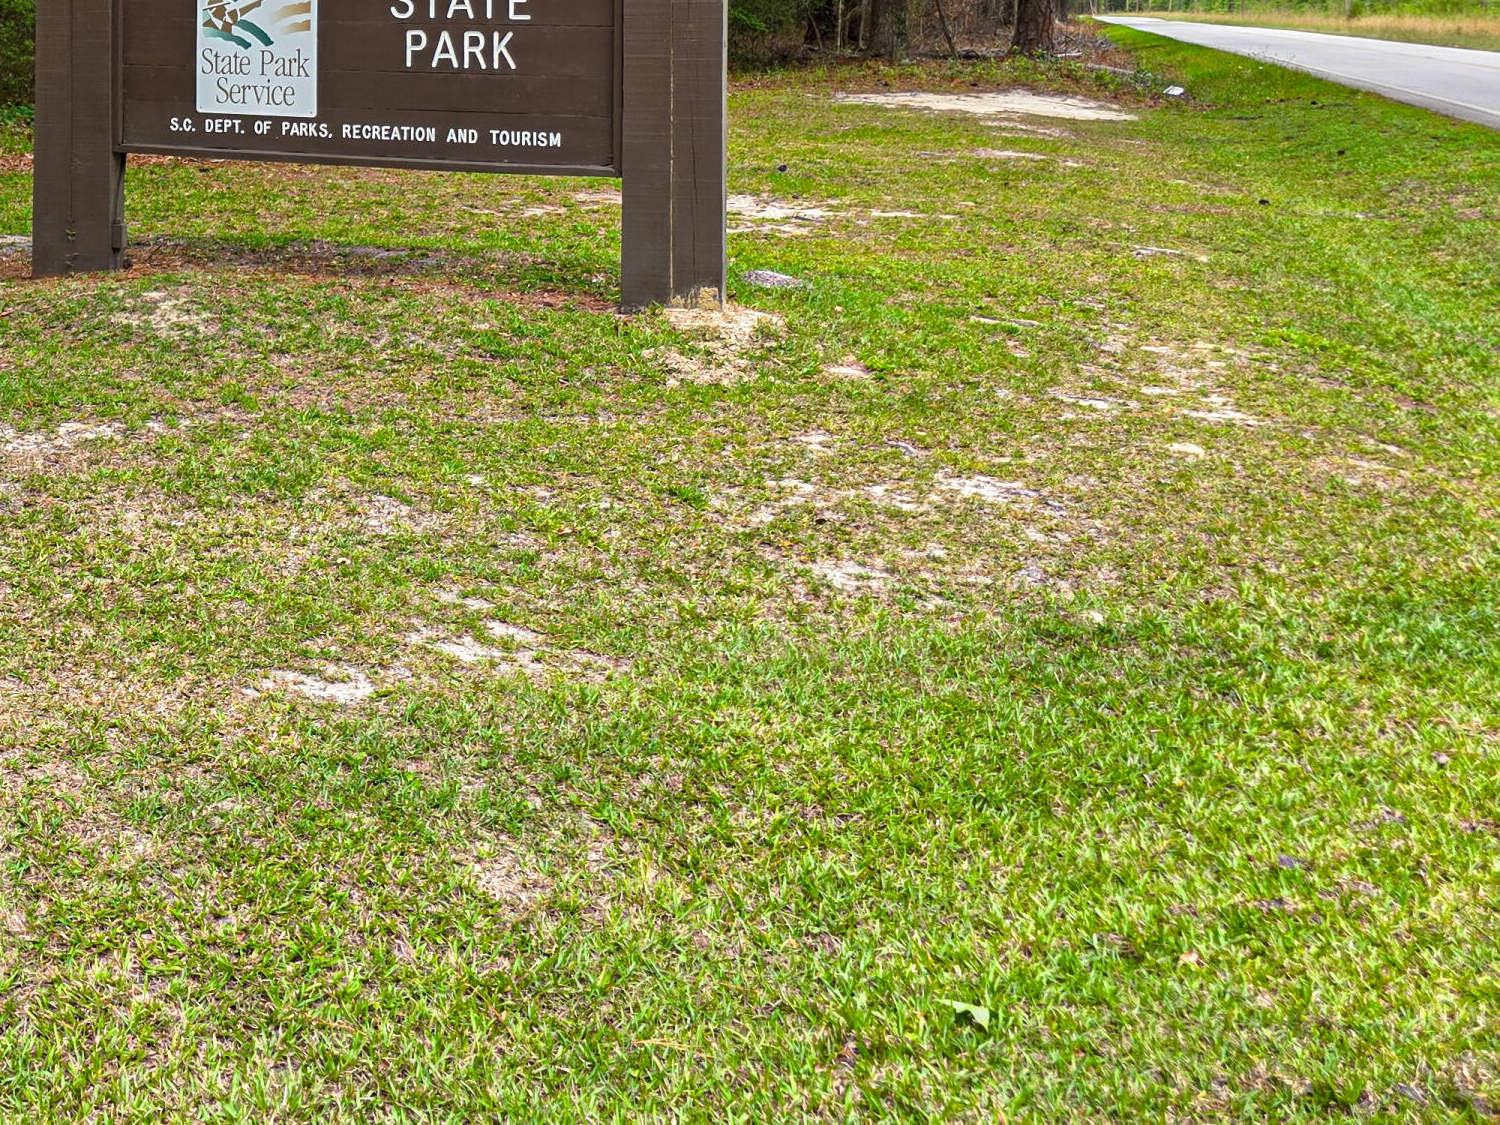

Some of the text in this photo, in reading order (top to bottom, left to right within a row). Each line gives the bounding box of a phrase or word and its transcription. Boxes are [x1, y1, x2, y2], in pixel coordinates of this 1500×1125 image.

[201, 47, 311, 78] State Park
[405, 29, 517, 70] PARK
[215, 76, 296, 106] Service
[169, 117, 561, 148] S.C. DEPT. OF PARKS, RECREATION AND TOURISM
